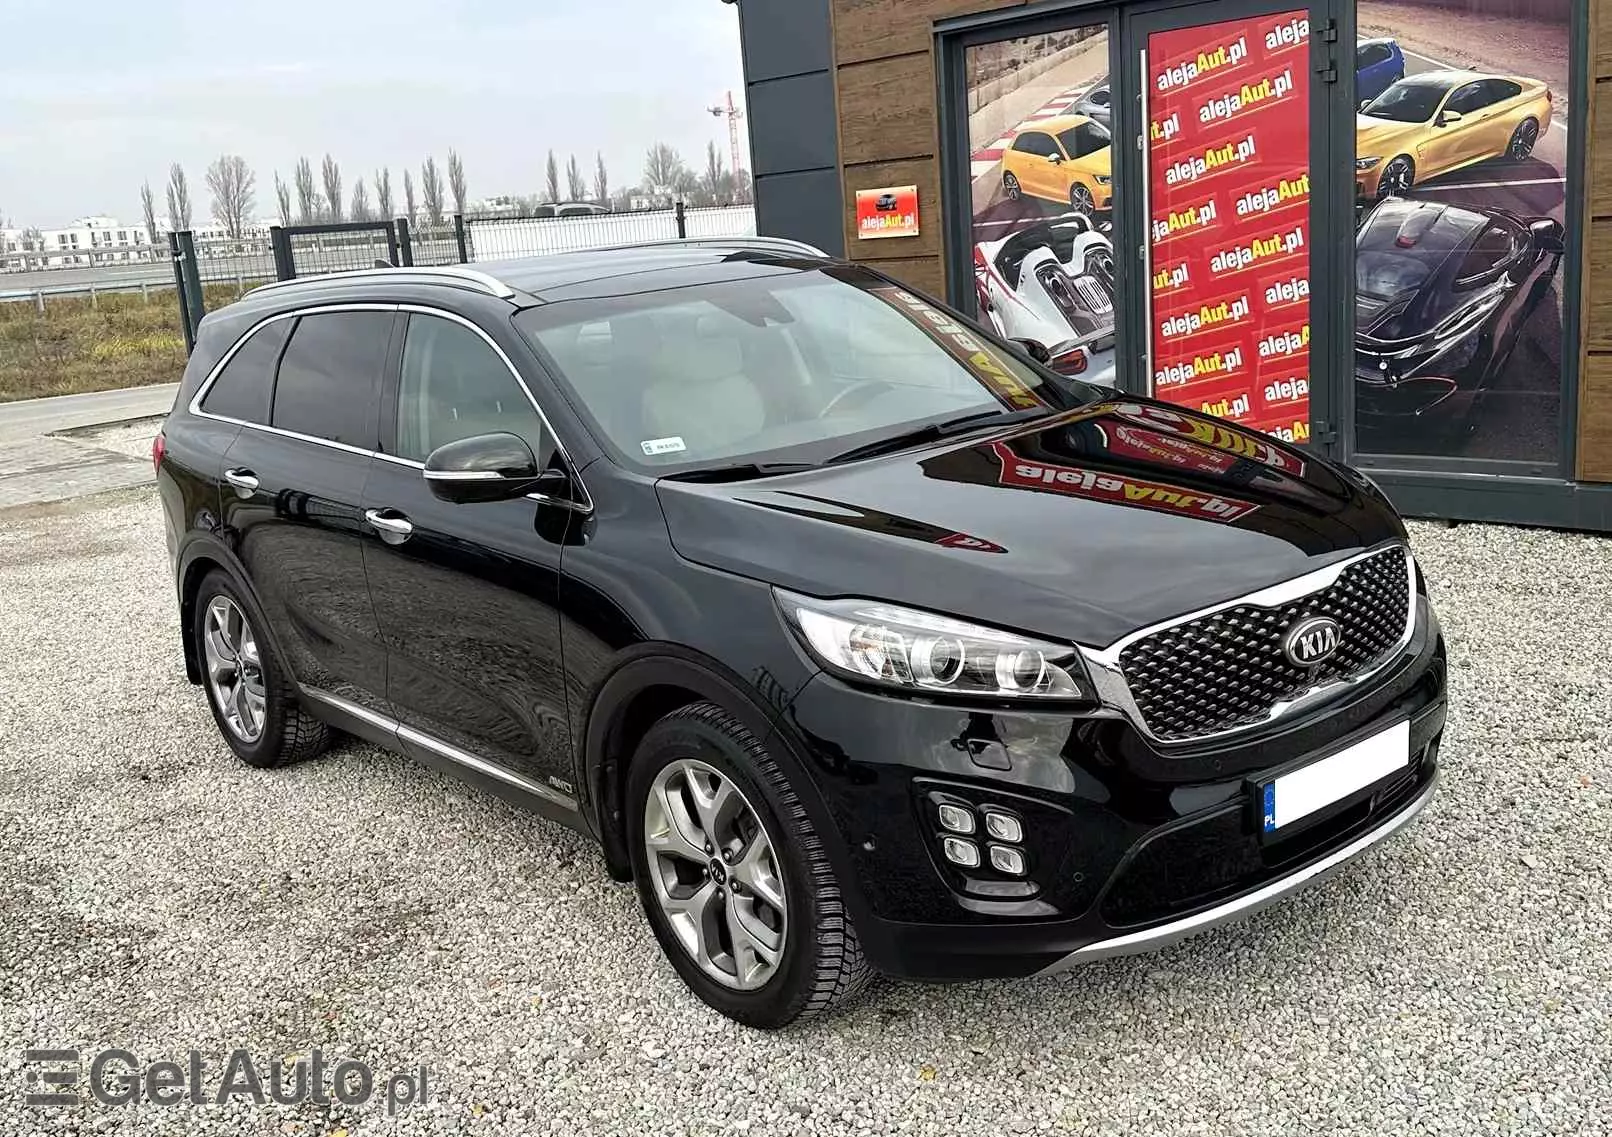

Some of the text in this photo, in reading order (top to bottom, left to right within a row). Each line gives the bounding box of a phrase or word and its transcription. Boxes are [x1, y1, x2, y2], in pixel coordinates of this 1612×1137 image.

[1156, 36, 1248, 91] alejaAut.pl
[1199, 69, 1293, 123] alejaAut.pl
[1164, 134, 1256, 185] alejaAut.pl
[861, 212, 915, 231] alejaAut.pl
[1210, 226, 1304, 273] alejaAut.pl
[1161, 295, 1249, 337] alejaAut.pl
[1155, 347, 1243, 386] alejaAut.pl
[1300, 626, 1337, 660] KIA
[1264, 814, 1275, 827] PL
